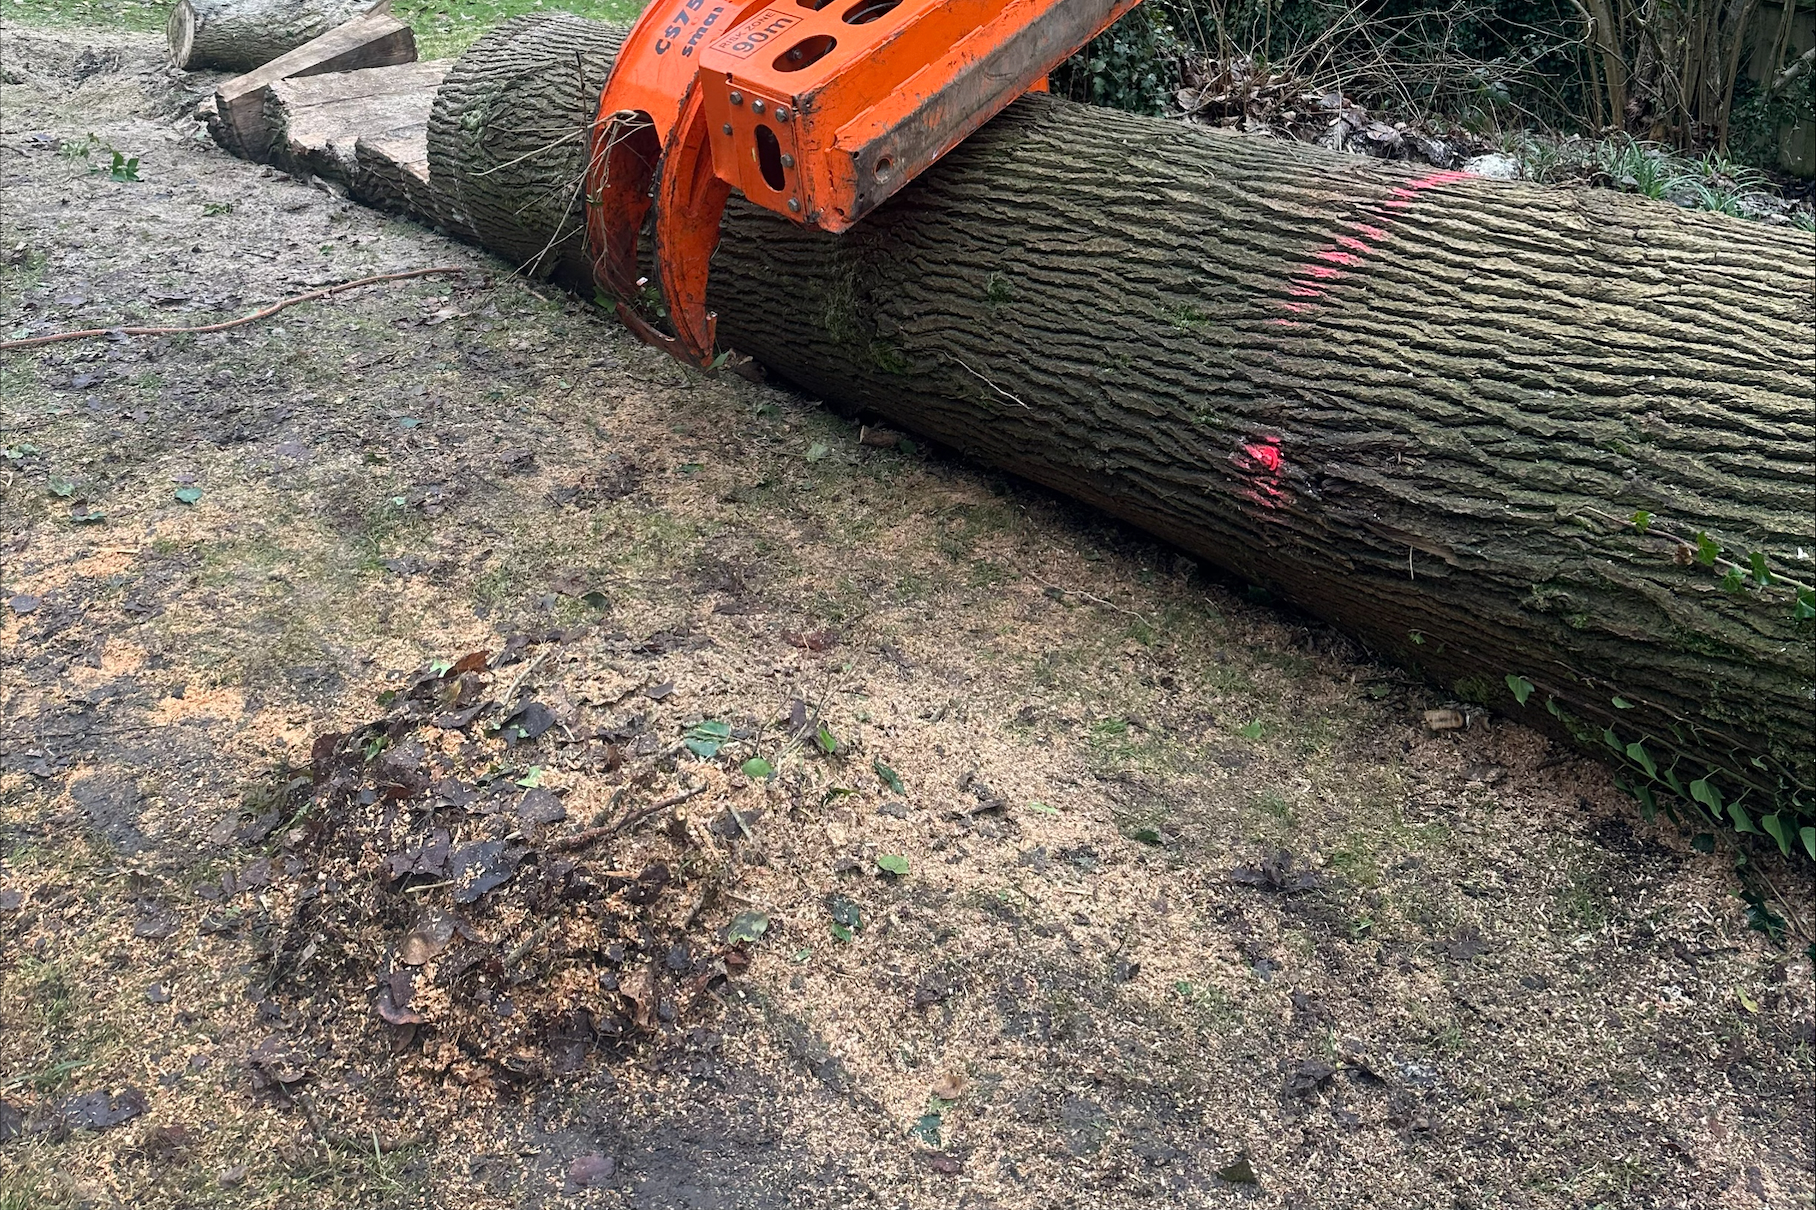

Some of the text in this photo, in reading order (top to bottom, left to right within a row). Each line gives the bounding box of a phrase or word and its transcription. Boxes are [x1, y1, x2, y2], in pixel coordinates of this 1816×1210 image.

[719, 12, 777, 49] RISK ZONE
[732, 17, 793, 53] 90m
